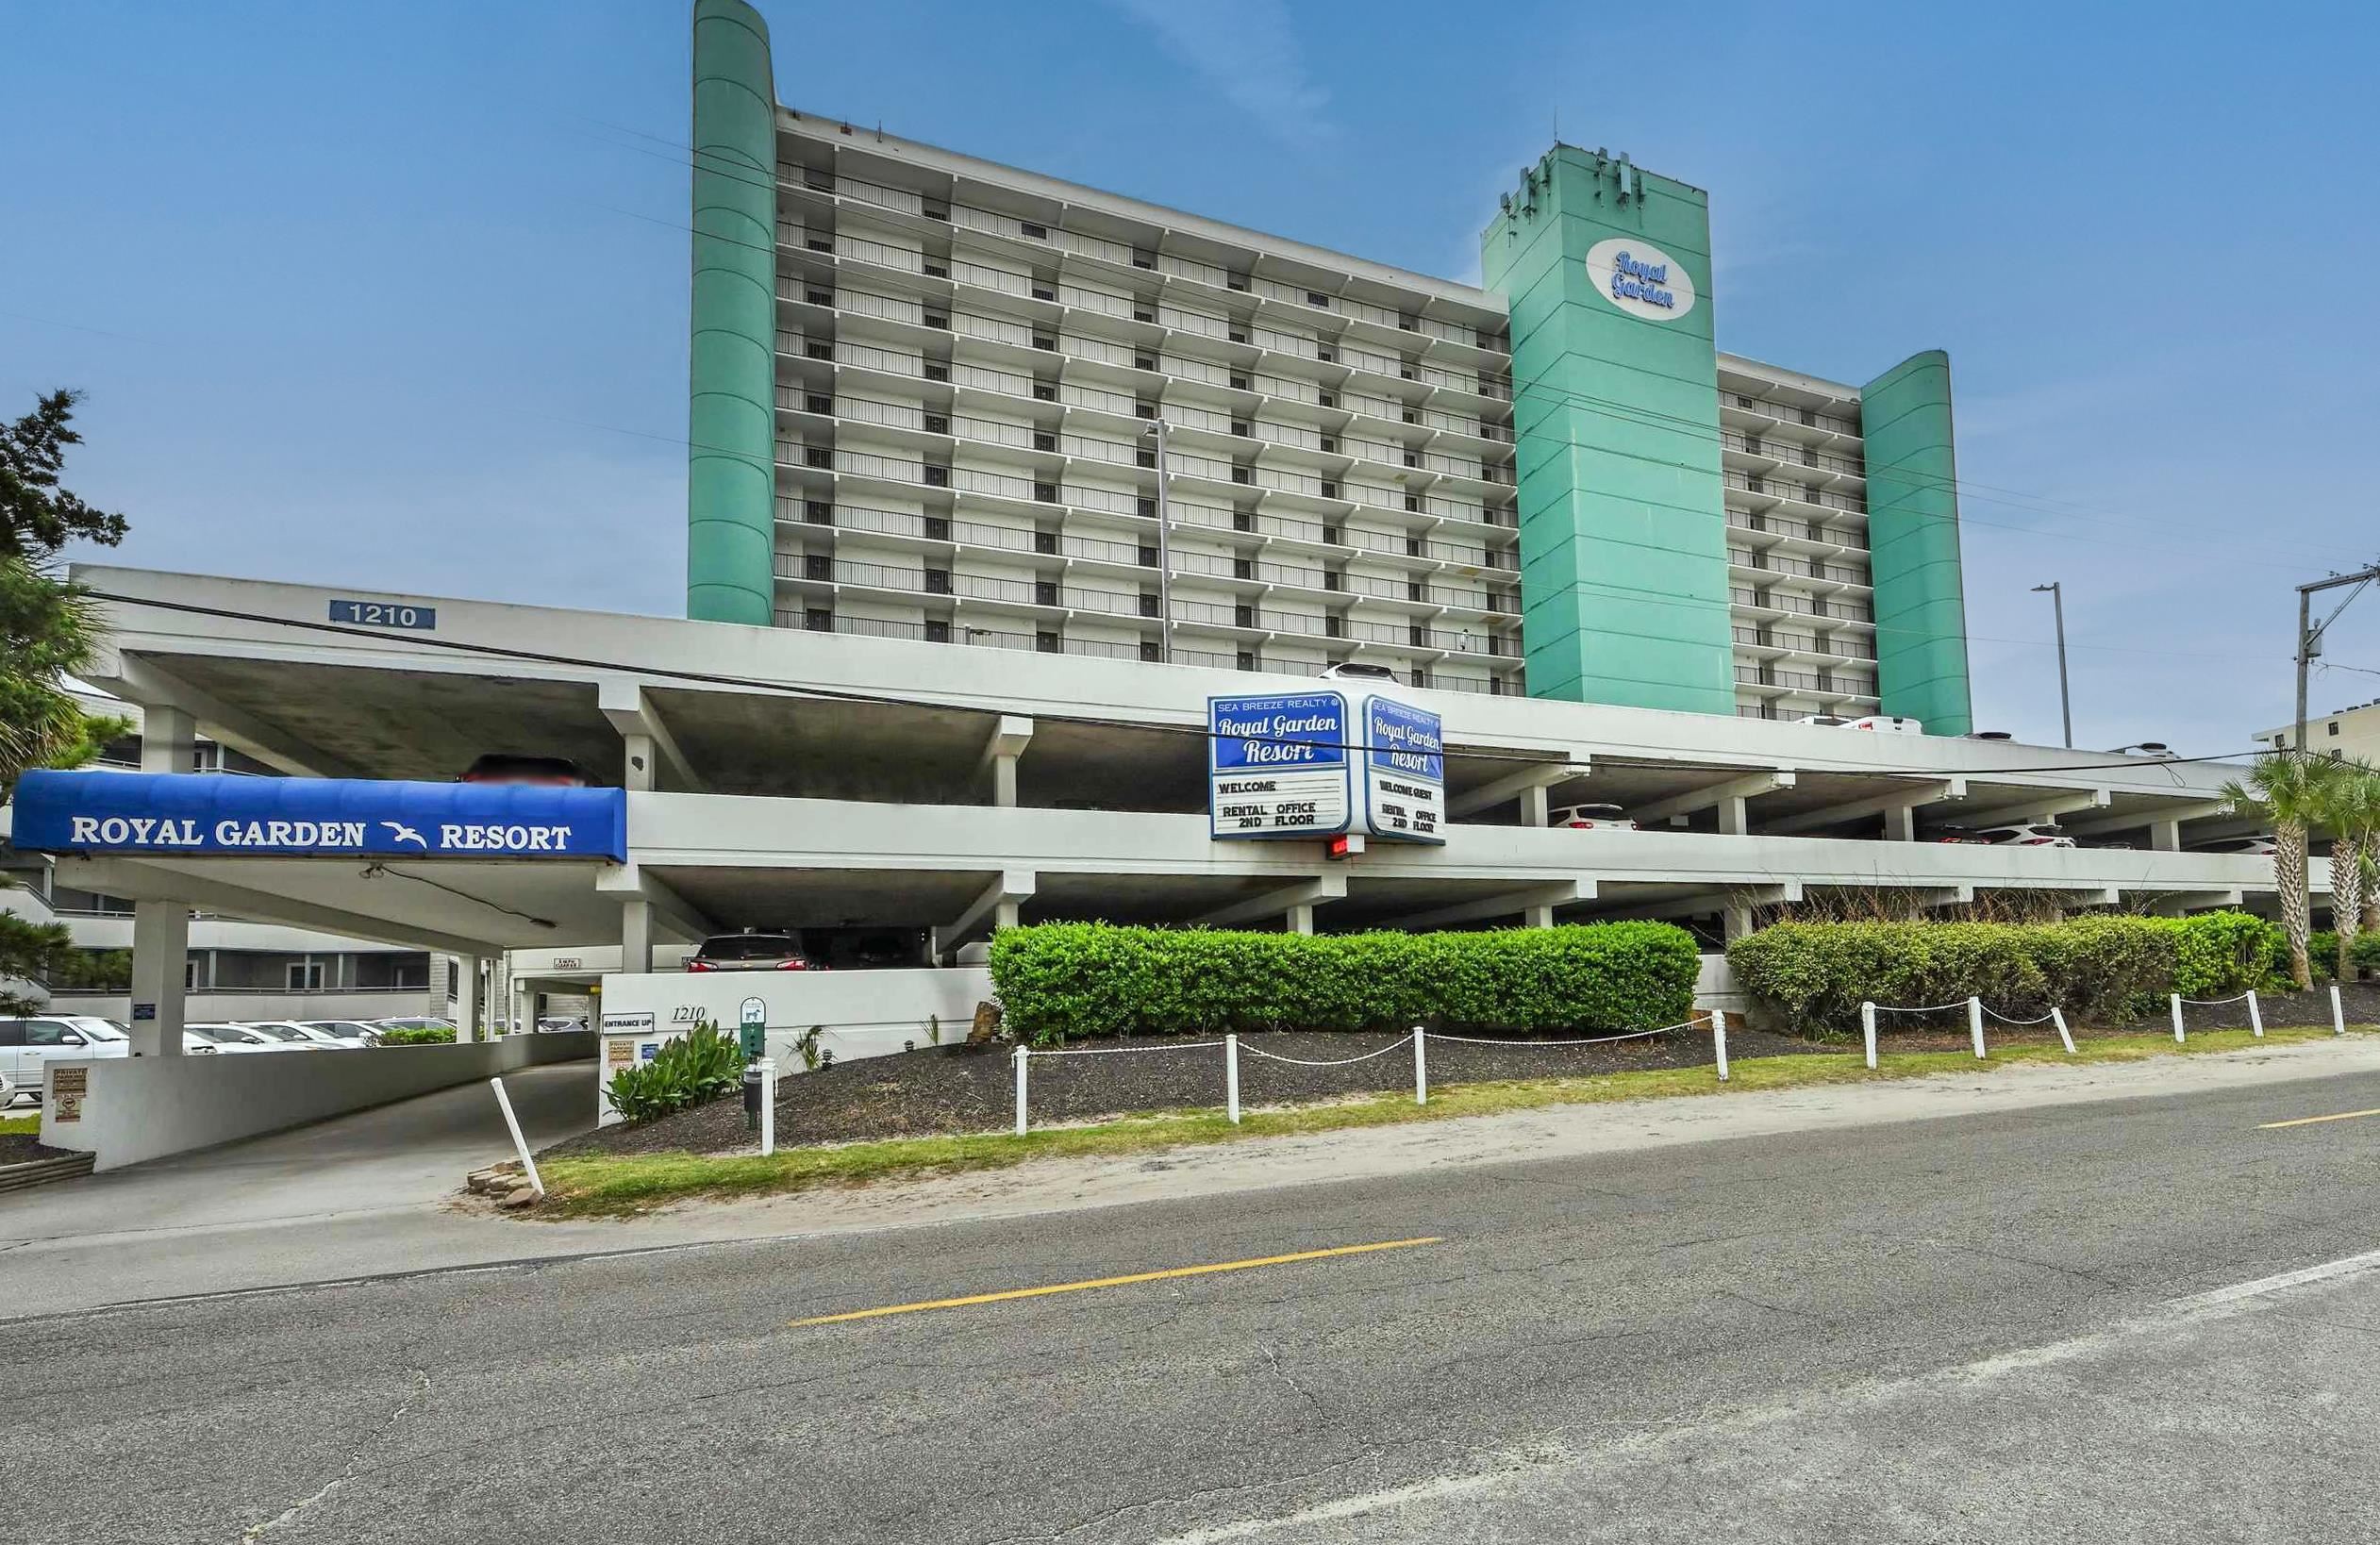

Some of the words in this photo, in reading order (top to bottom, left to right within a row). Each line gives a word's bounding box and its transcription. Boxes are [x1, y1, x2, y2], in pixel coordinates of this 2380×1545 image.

[1616, 251, 1668, 284] Royal
[1611, 273, 1674, 308] Garden
[349, 604, 416, 627] 1210
[1218, 704, 1239, 712] SEA
[1242, 701, 1284, 711] BREEZE
[1288, 699, 1328, 708] REALTY
[1219, 718, 1270, 737] Royal
[1273, 714, 1339, 738] Garden
[1374, 717, 1406, 742] Royal
[1406, 725, 1440, 751] Garden
[1243, 739, 1315, 763] Resort
[1390, 743, 1429, 772] Resort
[1219, 781, 1276, 794] WELCOME
[1380, 780, 1413, 796] WELCOME
[1223, 805, 1268, 817] RENTAL
[1276, 802, 1316, 814] OFFICE
[1239, 817, 1262, 827] 2ND
[1275, 815, 1314, 826] FLOOR
[71, 816, 204, 846] ROYAL
[215, 820, 366, 848] GARDEN
[441, 824, 572, 851] RESORT
[1413, 821, 1434, 833] FLOOR
[672, 1006, 706, 1021] 1210
